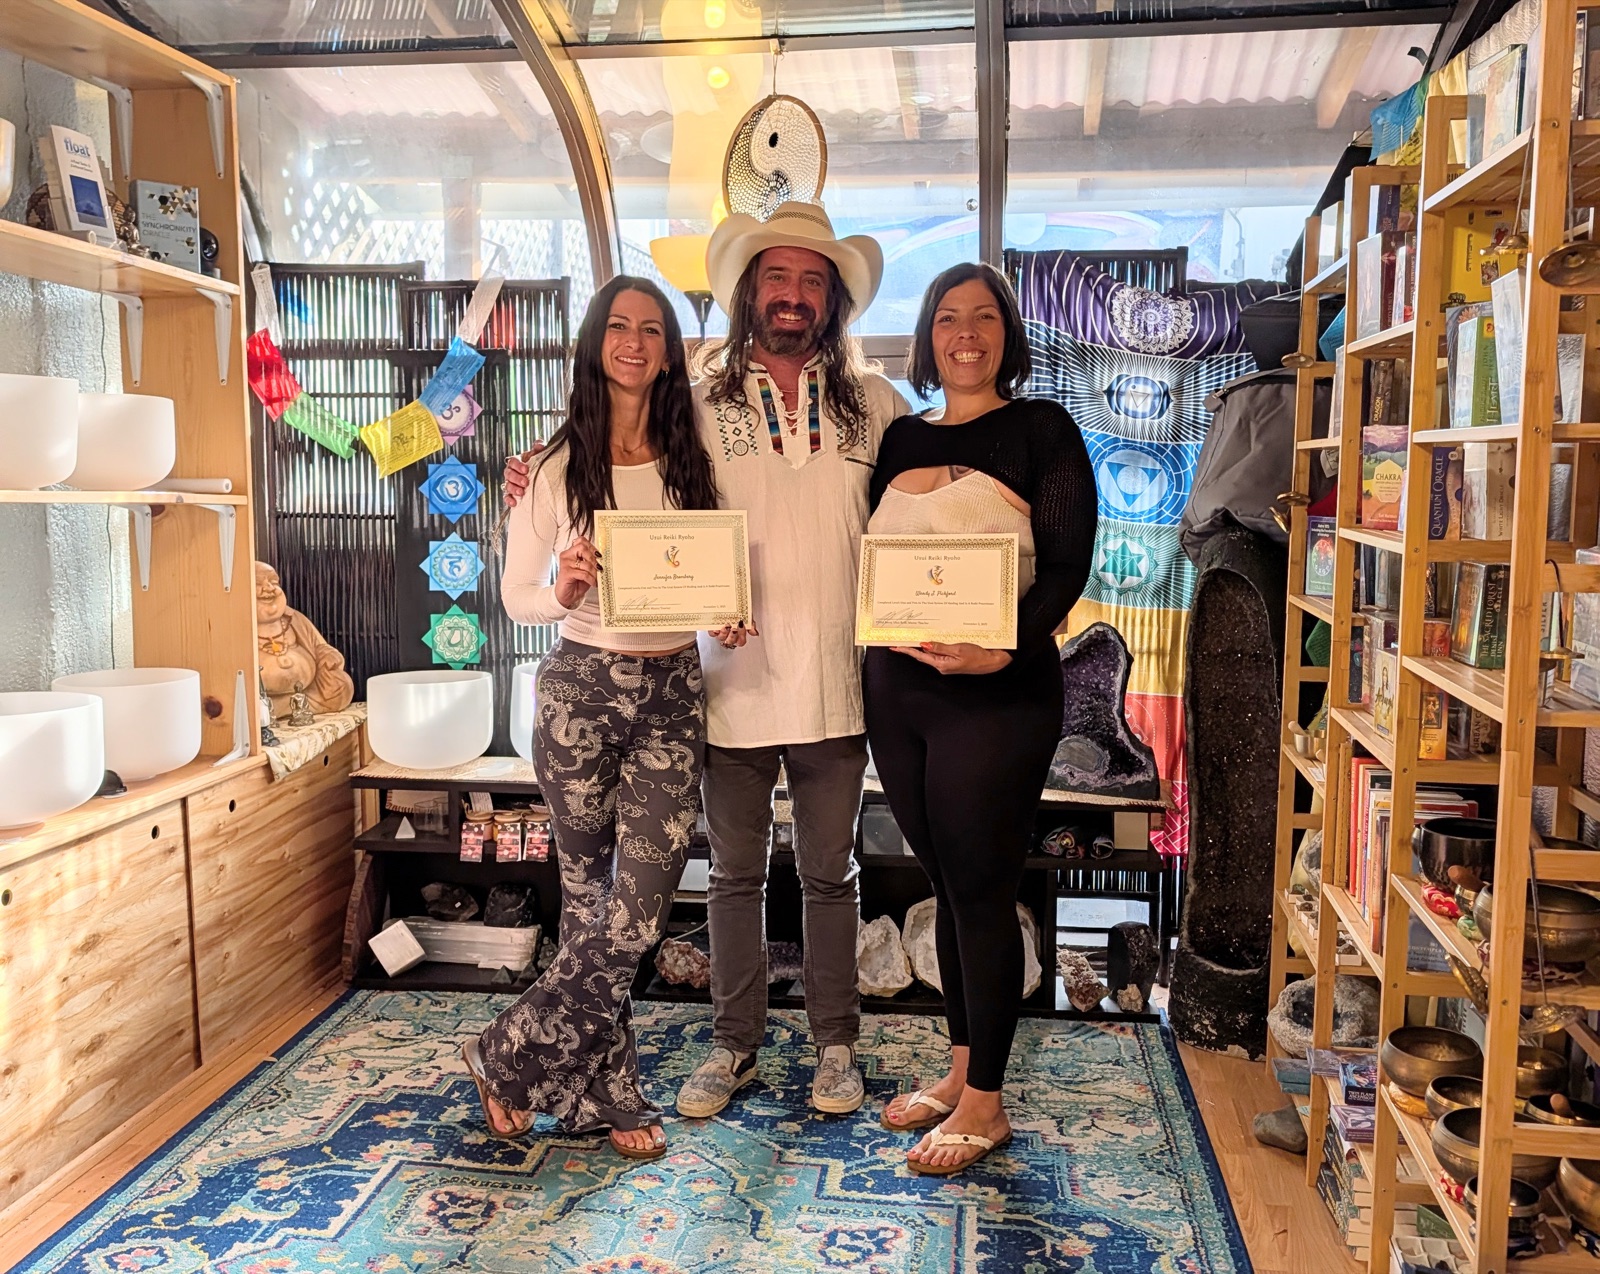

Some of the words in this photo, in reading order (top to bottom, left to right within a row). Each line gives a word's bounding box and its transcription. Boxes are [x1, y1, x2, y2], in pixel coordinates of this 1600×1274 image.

[64, 139, 91, 157] float
[1373, 397, 1381, 421] DRAGON
[1486, 377, 1499, 422] HEART
[1432, 456, 1445, 491] ORACLE
[1431, 494, 1444, 537] QUANTUM
[1480, 645, 1489, 657] THE
